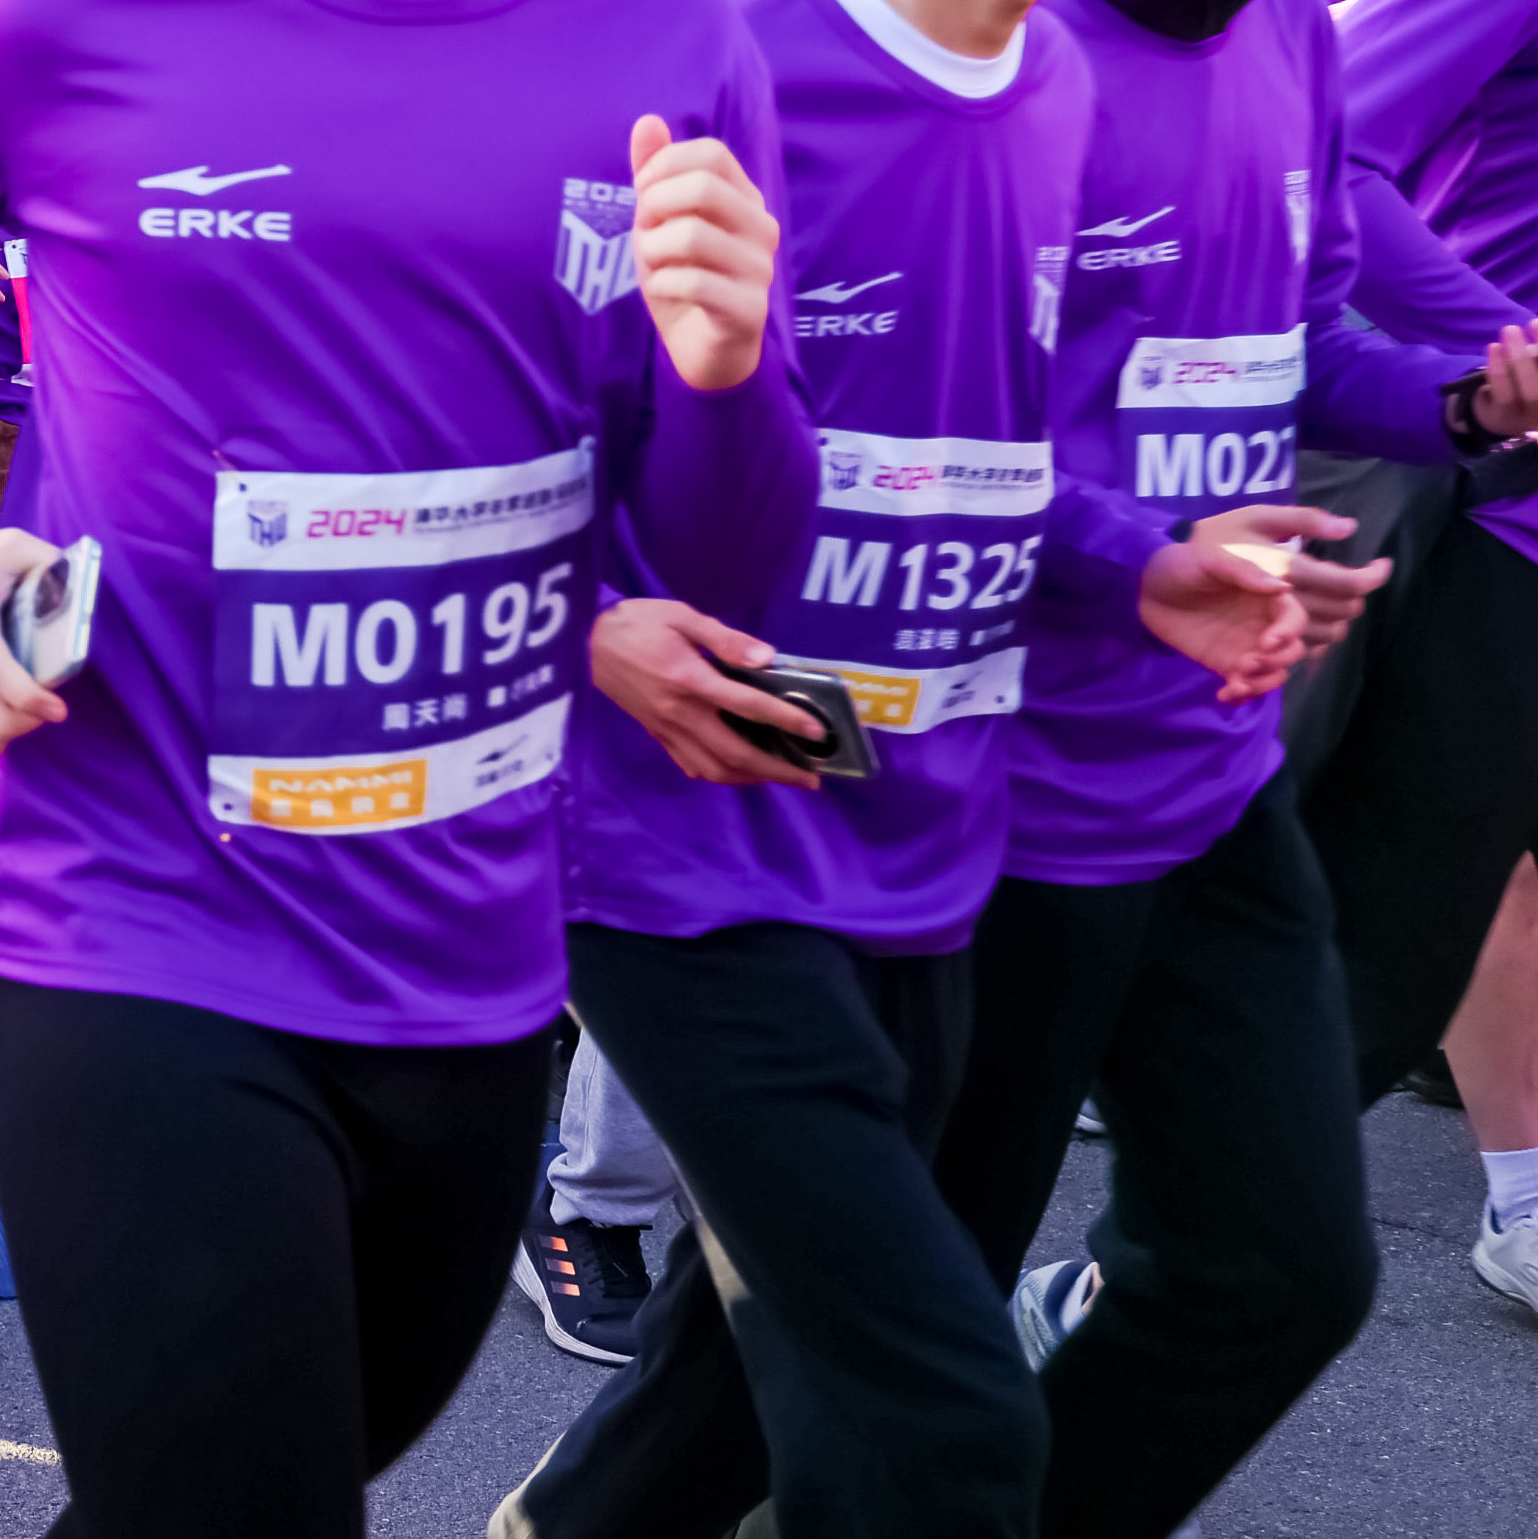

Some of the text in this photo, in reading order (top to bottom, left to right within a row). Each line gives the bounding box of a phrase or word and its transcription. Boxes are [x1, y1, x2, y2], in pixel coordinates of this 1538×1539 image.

[564, 178, 637, 206] 202
[138, 208, 292, 242] ERKE
[1075, 240, 1182, 271] ERKE
[795, 309, 899, 338] ERKE
[307, 510, 407, 539] 2024
[801, 535, 1043, 611] M1325
[251, 562, 573, 687] M0195
